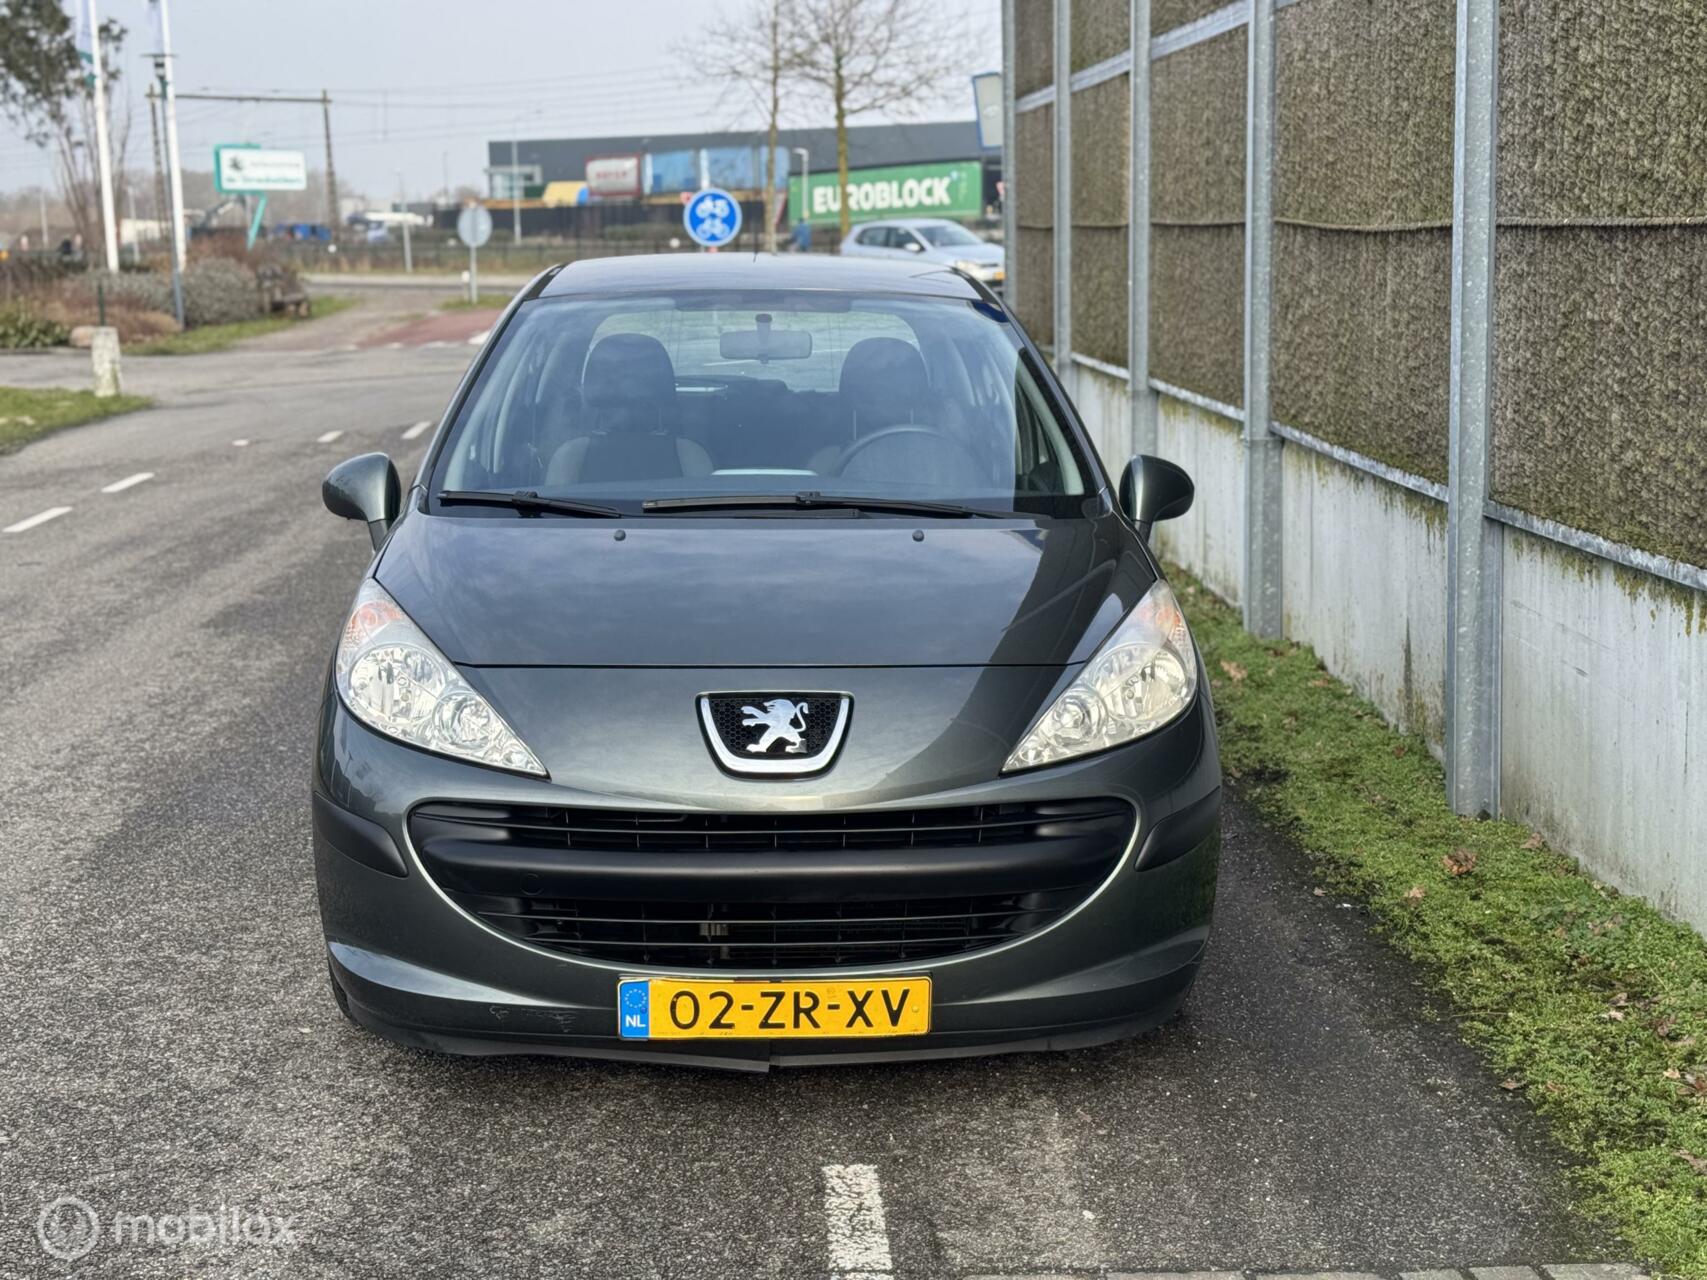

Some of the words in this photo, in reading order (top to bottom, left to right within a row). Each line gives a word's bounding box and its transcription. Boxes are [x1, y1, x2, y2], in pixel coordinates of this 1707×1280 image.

[812, 176, 952, 214] EUROBLOCK
[625, 1014, 647, 1028] NL
[669, 988, 911, 1030] 02-ZR-XV
